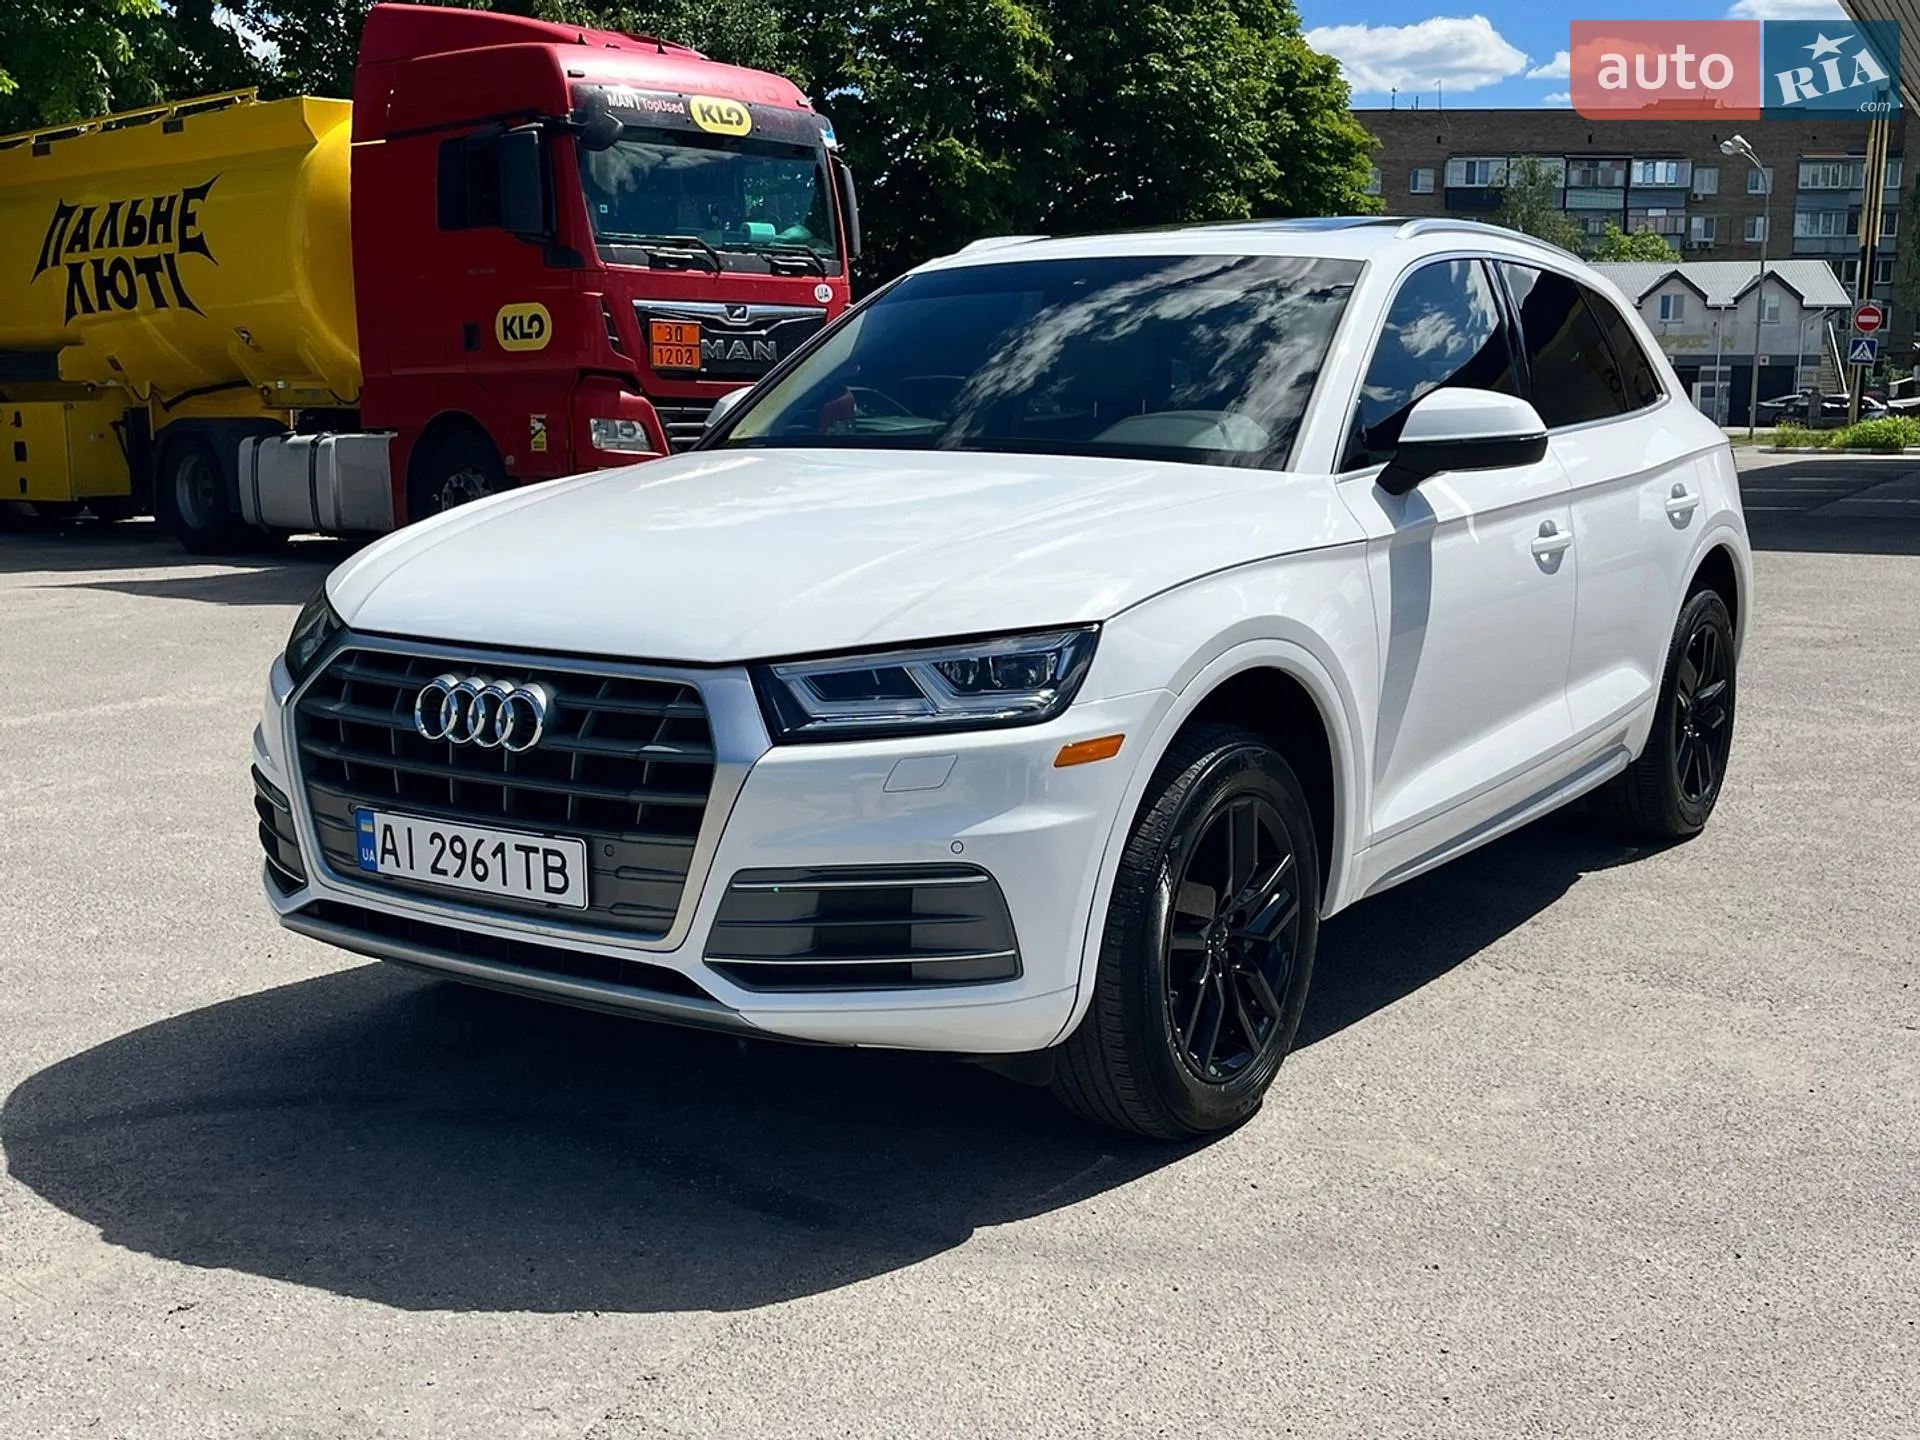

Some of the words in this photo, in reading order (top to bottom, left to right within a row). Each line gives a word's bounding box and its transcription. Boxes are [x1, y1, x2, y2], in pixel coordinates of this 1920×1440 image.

[607, 94, 635, 110] MAN
[641, 97, 685, 115] TopUsed
[700, 104, 744, 127] KLO
[30, 171, 224, 285] ПАЛЬНЕ
[63, 252, 208, 328] ЛЮТІ
[817, 287, 830, 299] UA
[502, 313, 545, 341] KLO
[664, 326, 684, 343] 30
[657, 347, 693, 365] 1202
[701, 338, 778, 361] MAN
[361, 847, 376, 862] UA
[379, 823, 415, 870] AI
[429, 831, 570, 895] 2961TB
